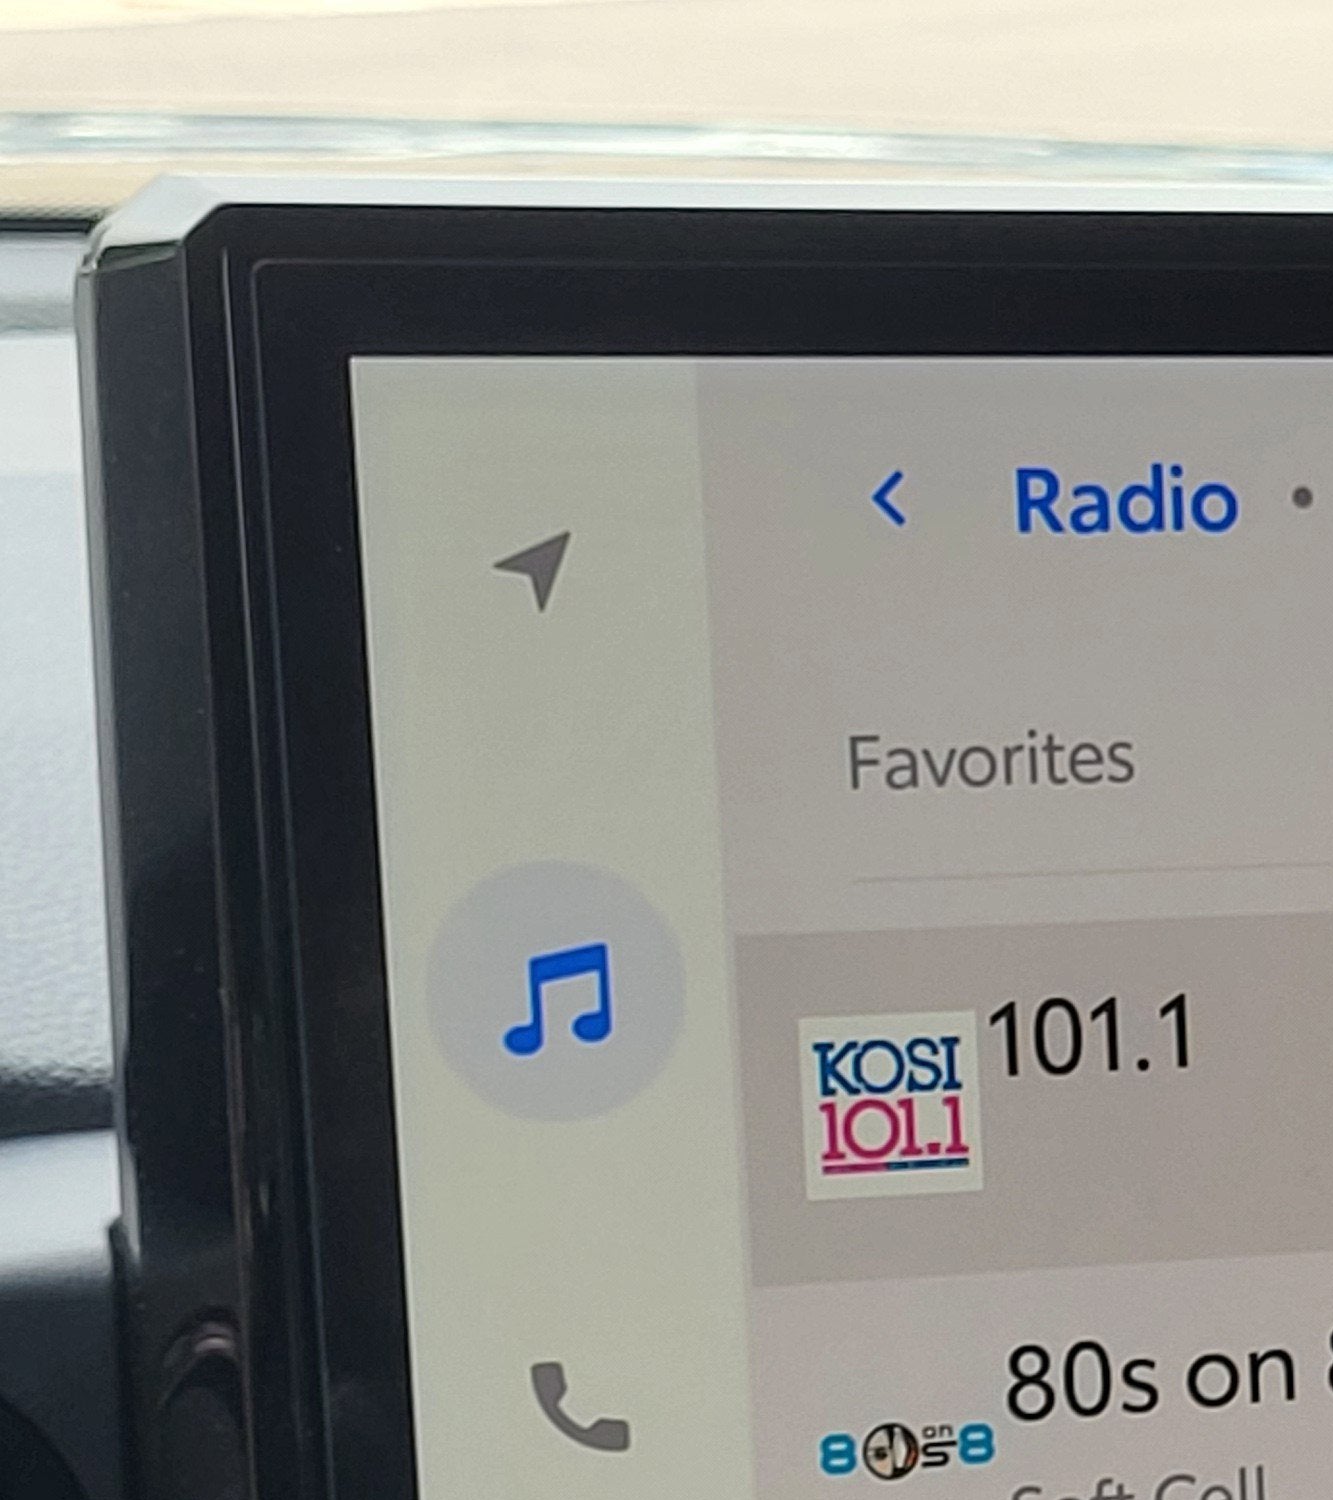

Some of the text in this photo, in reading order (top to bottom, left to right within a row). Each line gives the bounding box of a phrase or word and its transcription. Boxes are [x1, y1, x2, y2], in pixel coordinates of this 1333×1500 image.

[1015, 464, 1239, 536] Radio
[849, 729, 1135, 791] Favorites
[813, 1036, 962, 1096] KOSI
[990, 994, 1188, 1076] 101.1
[820, 1096, 969, 1160] 101.1
[1007, 1340, 1159, 1422] 80s
[1186, 1348, 1295, 1408] on
